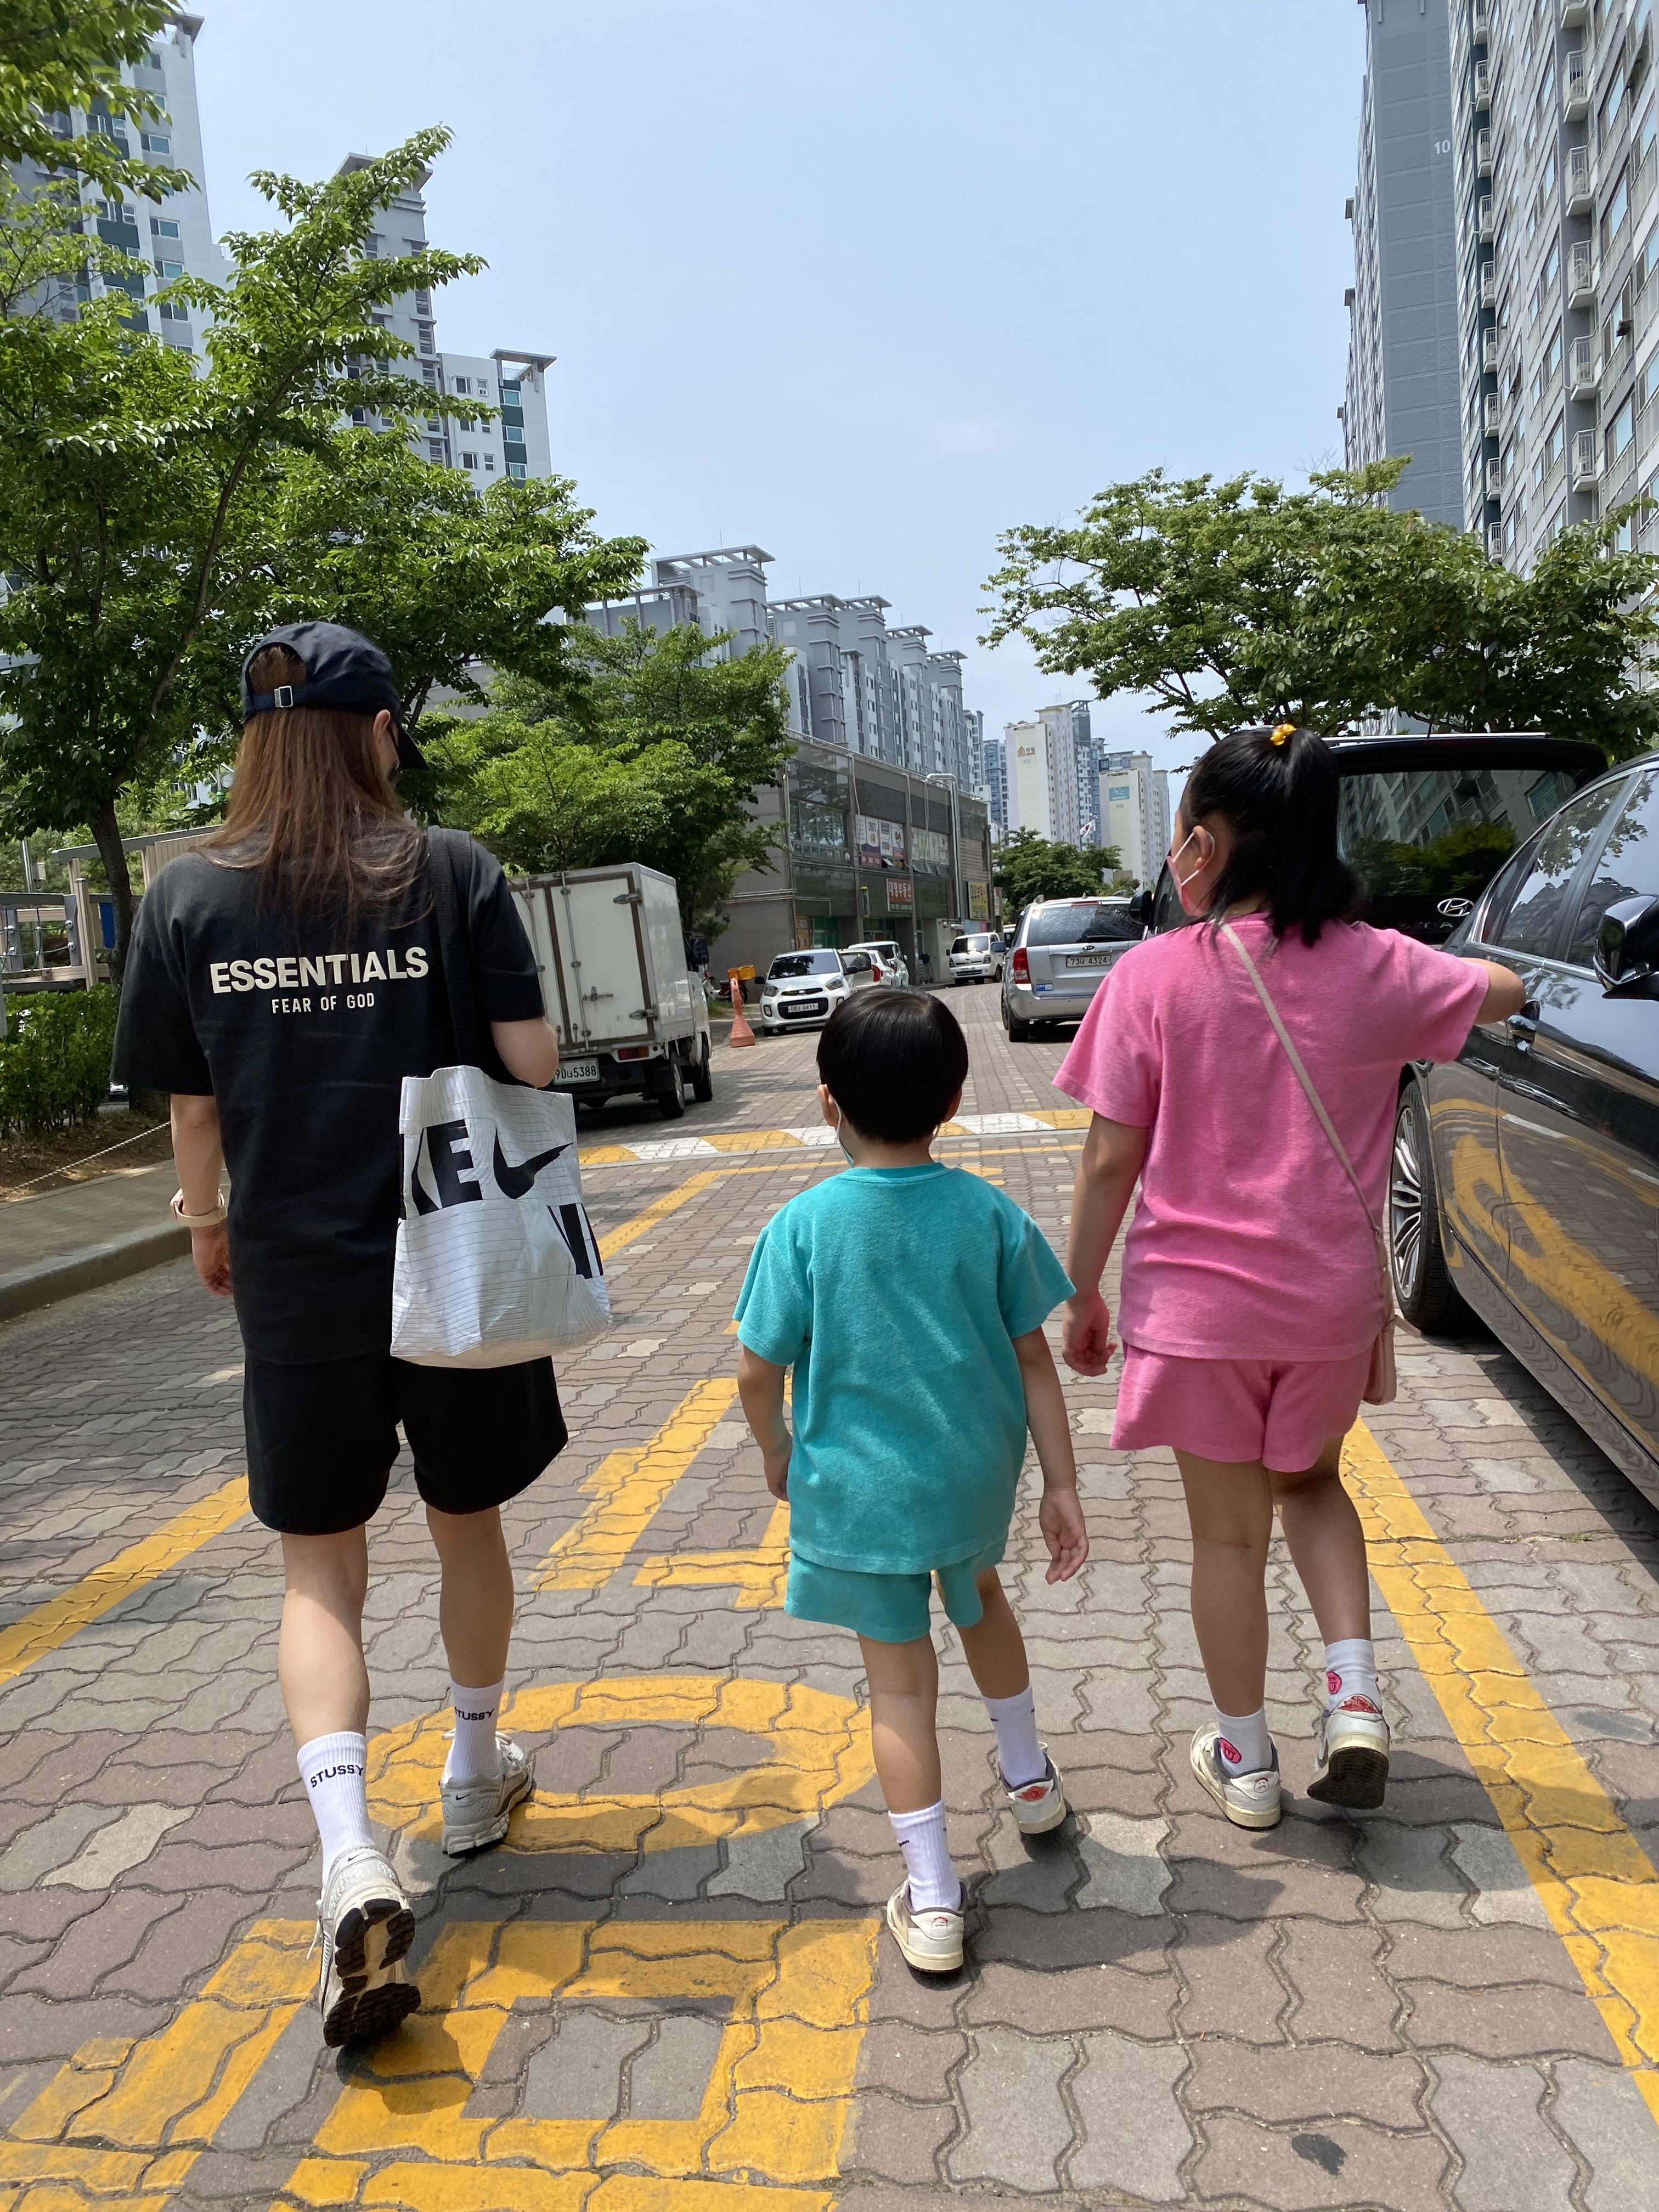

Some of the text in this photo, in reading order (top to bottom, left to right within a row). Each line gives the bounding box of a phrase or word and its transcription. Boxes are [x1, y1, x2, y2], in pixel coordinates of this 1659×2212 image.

[210, 947, 429, 994] ESSENTIALS
[272, 992, 375, 1013] FEAR OF GOD
[311, 1764, 364, 1788] STUSSY
